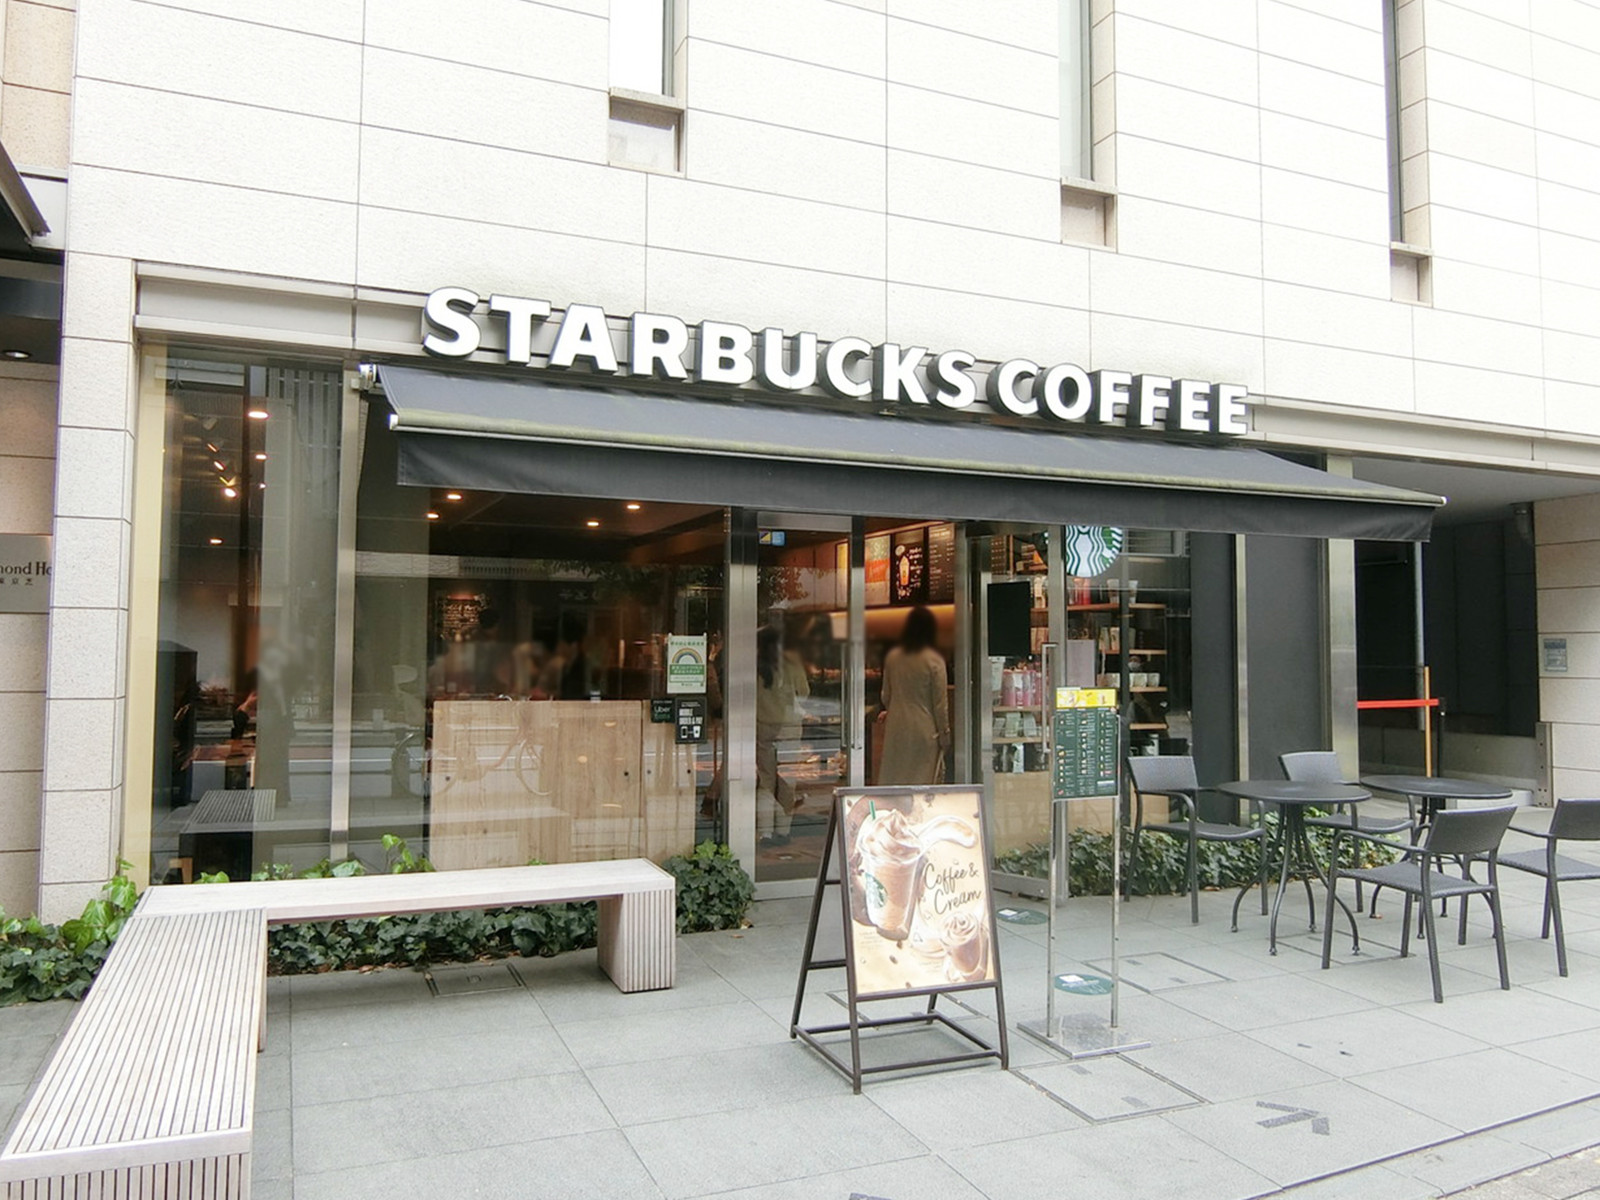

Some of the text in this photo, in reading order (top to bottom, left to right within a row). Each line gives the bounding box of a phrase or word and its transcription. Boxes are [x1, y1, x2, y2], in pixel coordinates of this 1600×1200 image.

[422, 286, 1248, 435] STARBUCKS COFFEE
[654, 705, 671, 713] Uber
[924, 862, 980, 895] Coffee &
[934, 888, 982, 915] Cream
